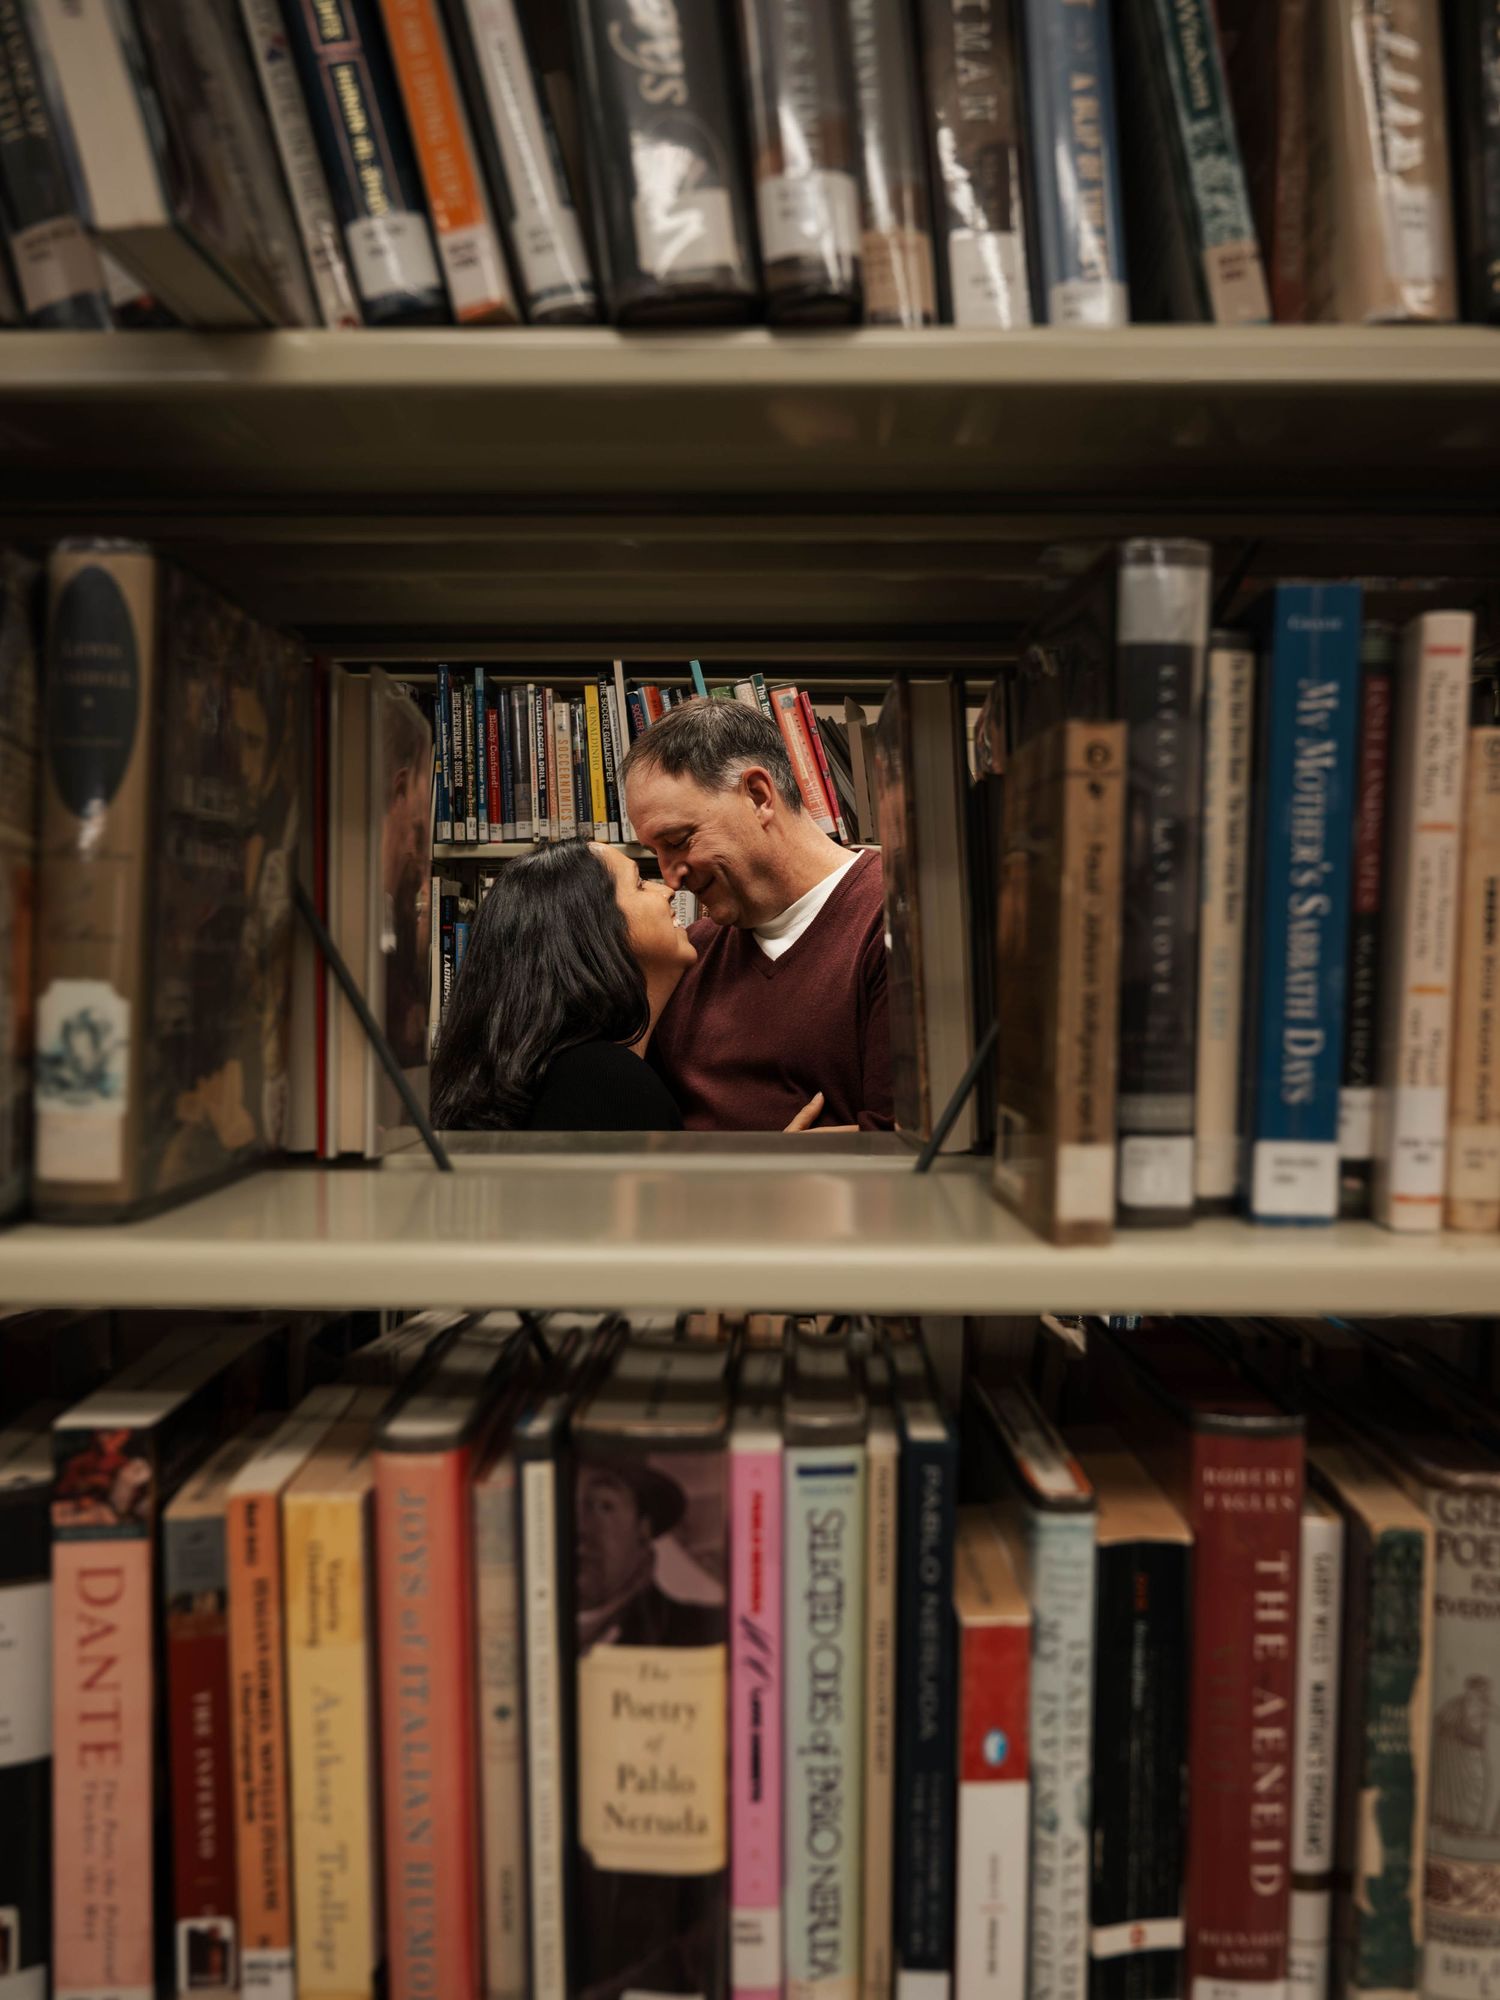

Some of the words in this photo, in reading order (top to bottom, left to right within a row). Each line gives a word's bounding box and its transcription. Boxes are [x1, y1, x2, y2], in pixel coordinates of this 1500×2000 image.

[599, 680, 607, 696] THE
[756, 684, 768, 701] The
[453, 692, 462, 758] HIGH-PERFORMANCE
[488, 714, 498, 741] Bloody
[601, 697, 610, 730] SOCCER
[631, 703, 644, 729] SOCCER
[537, 725, 545, 759] SOCCER
[588, 705, 600, 771] RONALDINHO
[602, 731, 614, 783] GOALKEEPER
[454, 760, 463, 787] SOCCER
[490, 744, 499, 788] Confused!
[558, 739, 572, 822] SOCCERNOMICS
[395, 1488, 430, 1599] JOYS
[921, 1463, 943, 1586] PABLO
[1253, 1549, 1291, 1661] THE
[398, 1607, 429, 1651] of
[77, 1565, 125, 1769] DANTE
[918, 1590, 941, 1742] NERUDA
[611, 1688, 697, 1734] Poetry
[399, 1662, 433, 1848] ITALIAN
[616, 1763, 697, 1796] Pablo
[1250, 1687, 1289, 1898] AENEID
[604, 1801, 709, 1837] Neruda
